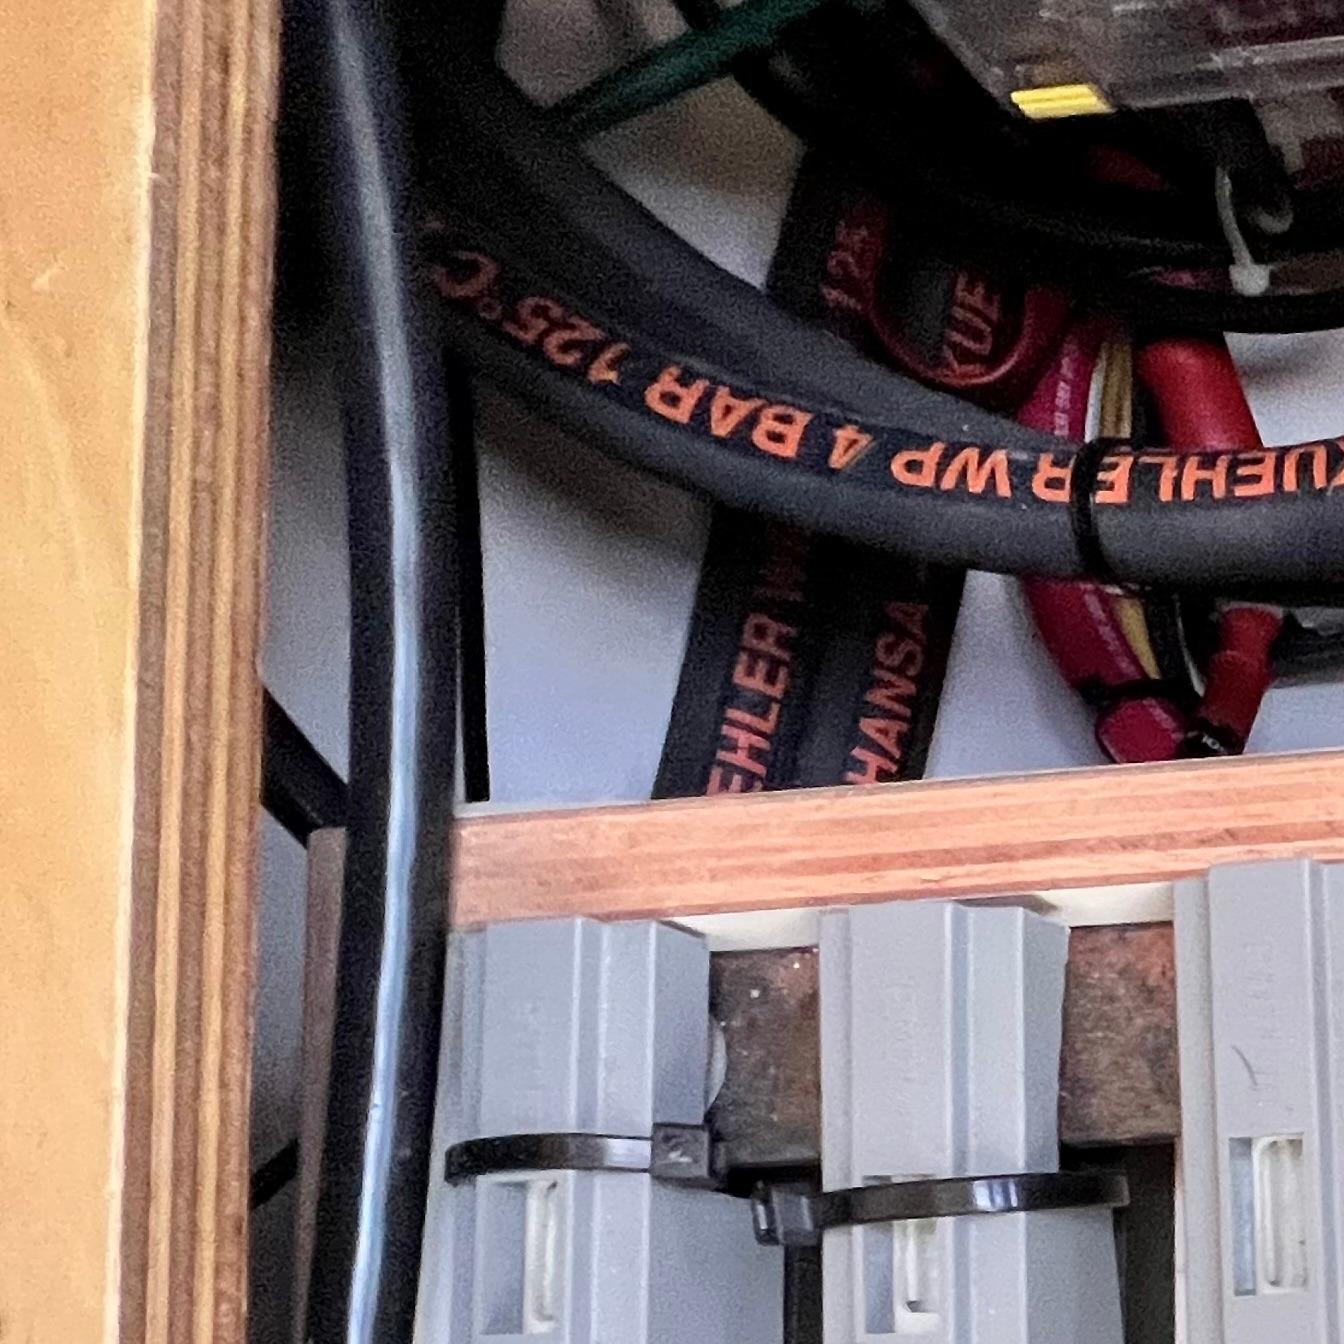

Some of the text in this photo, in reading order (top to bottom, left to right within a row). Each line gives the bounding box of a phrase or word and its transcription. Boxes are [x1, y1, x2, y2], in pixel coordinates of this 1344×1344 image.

[432, 250, 632, 390] 125°C
[646, 362, 815, 461] BAR
[827, 430, 882, 470] 4
[890, 441, 1013, 498] WP
[846, 600, 929, 787] HANSA
